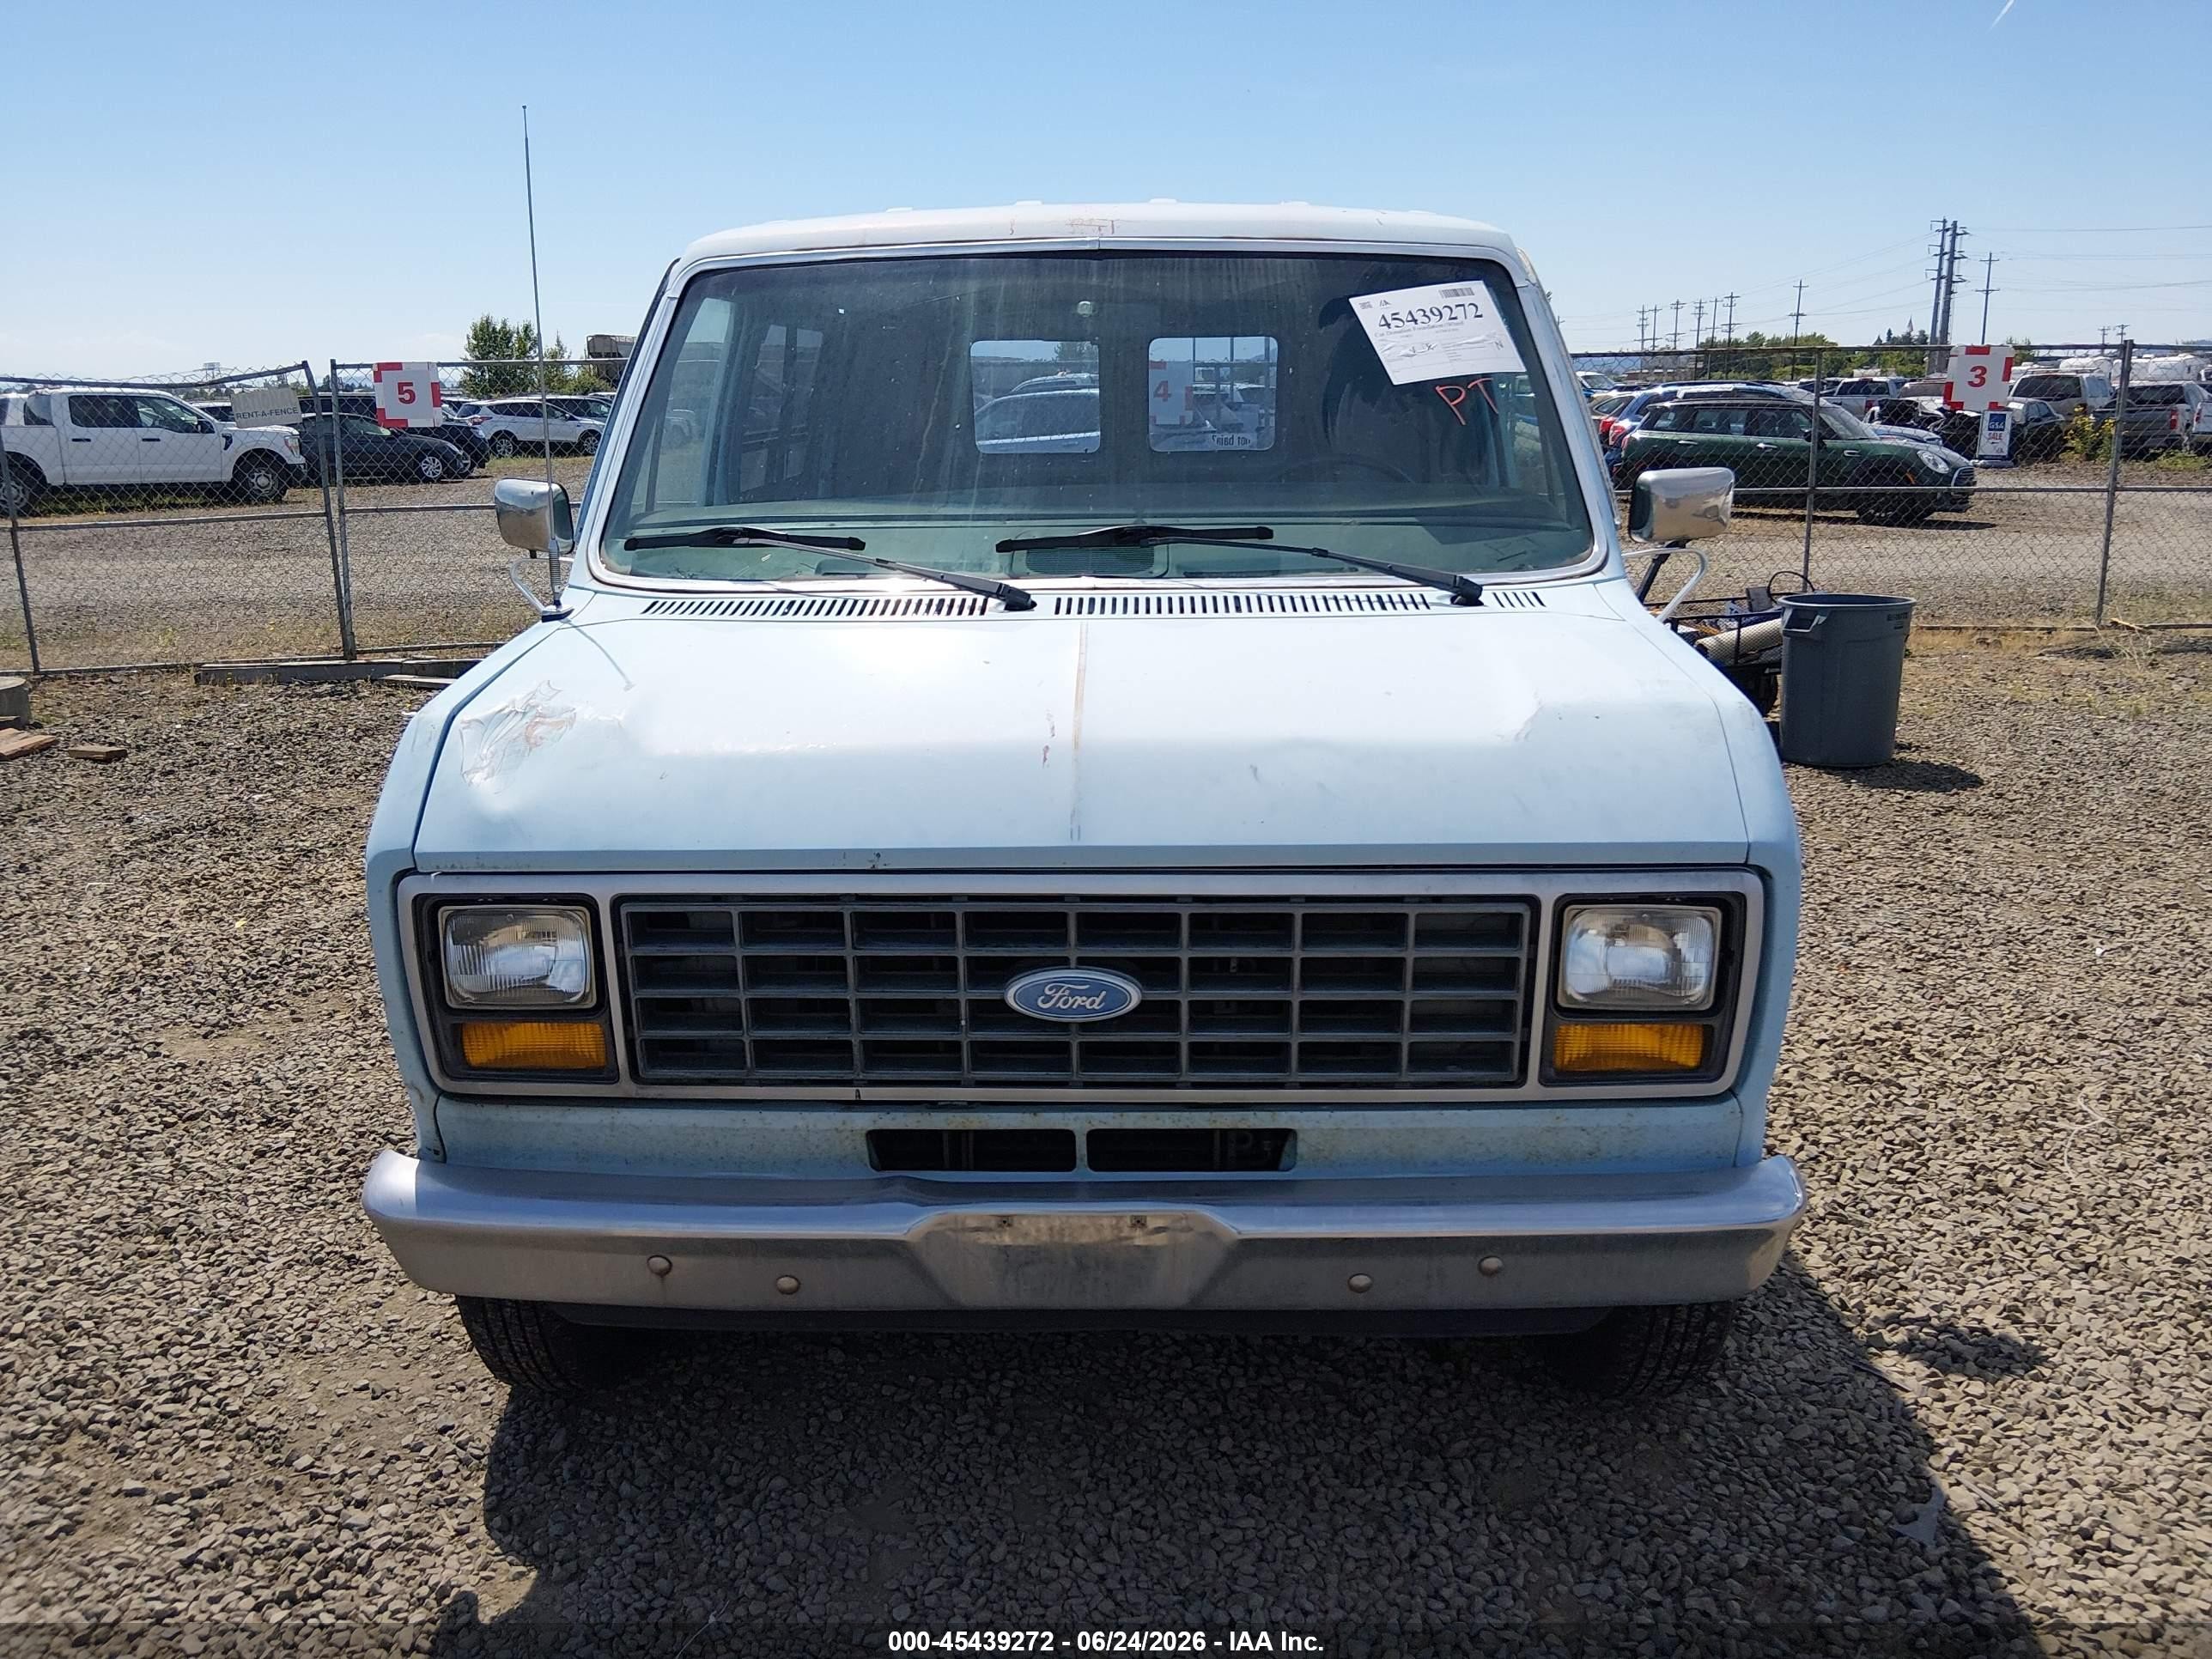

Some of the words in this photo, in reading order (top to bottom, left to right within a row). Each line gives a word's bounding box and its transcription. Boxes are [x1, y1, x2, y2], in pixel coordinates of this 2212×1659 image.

[1378, 302, 1484, 330] 45439272
[1967, 365, 1987, 387] 3
[398, 382, 416, 404] 5
[1153, 380, 1172, 402] 4
[1435, 377, 1498, 426] PT
[236, 406, 299, 420] RENT-A-FENCE
[1036, 982, 1107, 1010] Ford
